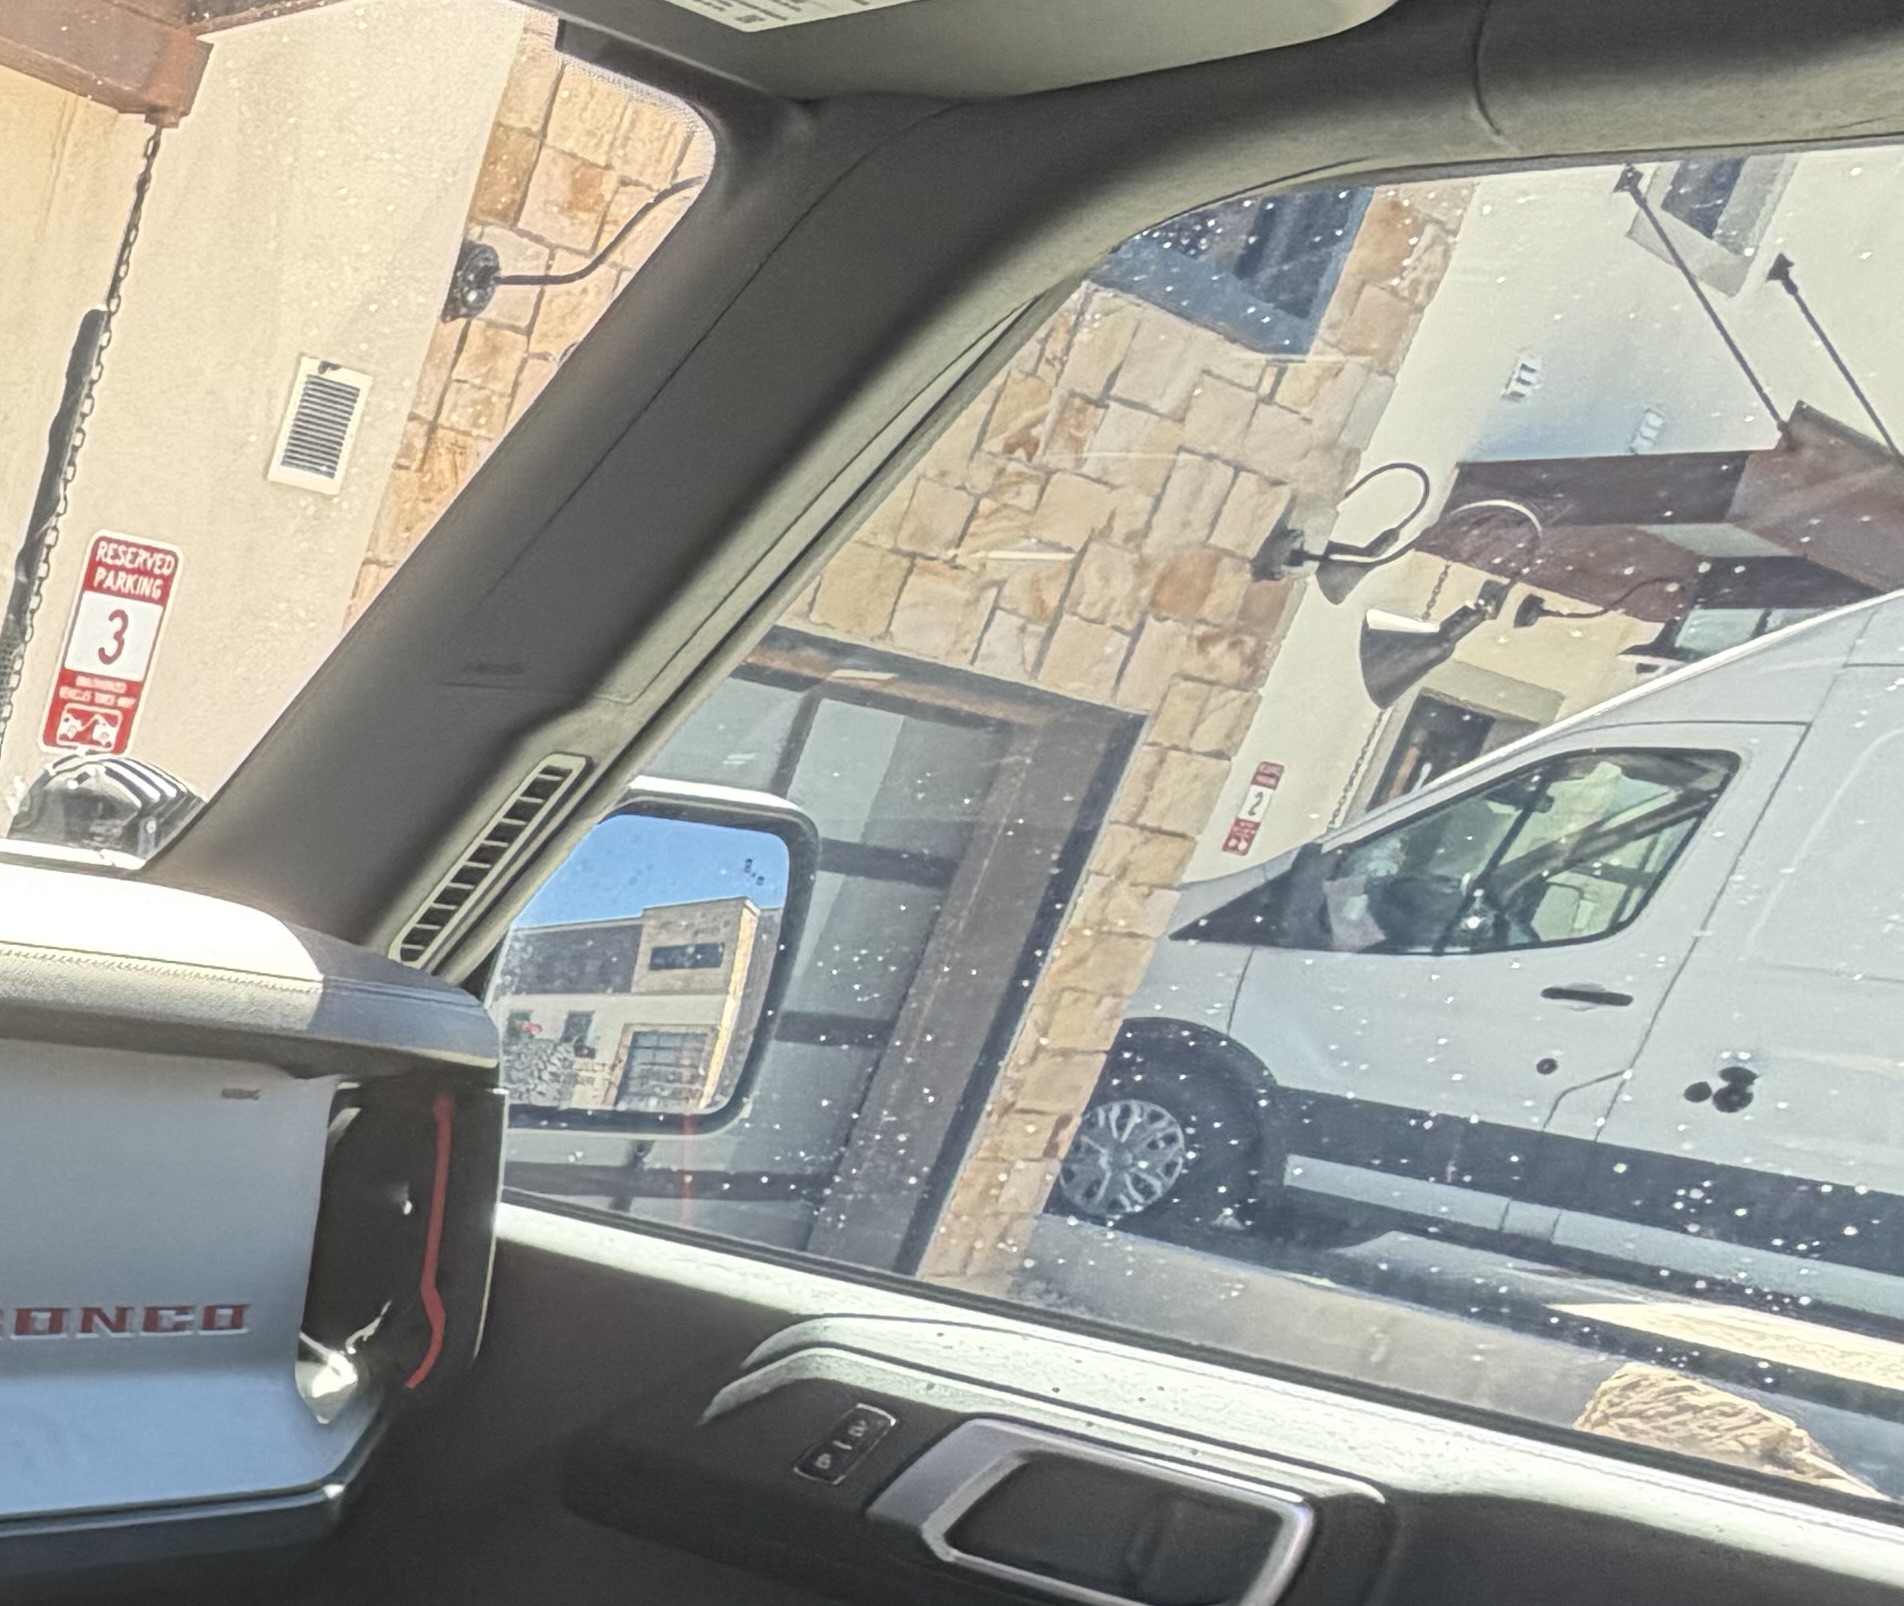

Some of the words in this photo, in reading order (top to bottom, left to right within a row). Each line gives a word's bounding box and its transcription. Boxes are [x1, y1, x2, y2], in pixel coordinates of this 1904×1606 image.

[95, 540, 176, 577] RESERVED
[93, 566, 164, 600] PARKING
[97, 609, 129, 665] 3
[1247, 791, 1265, 817] 2
